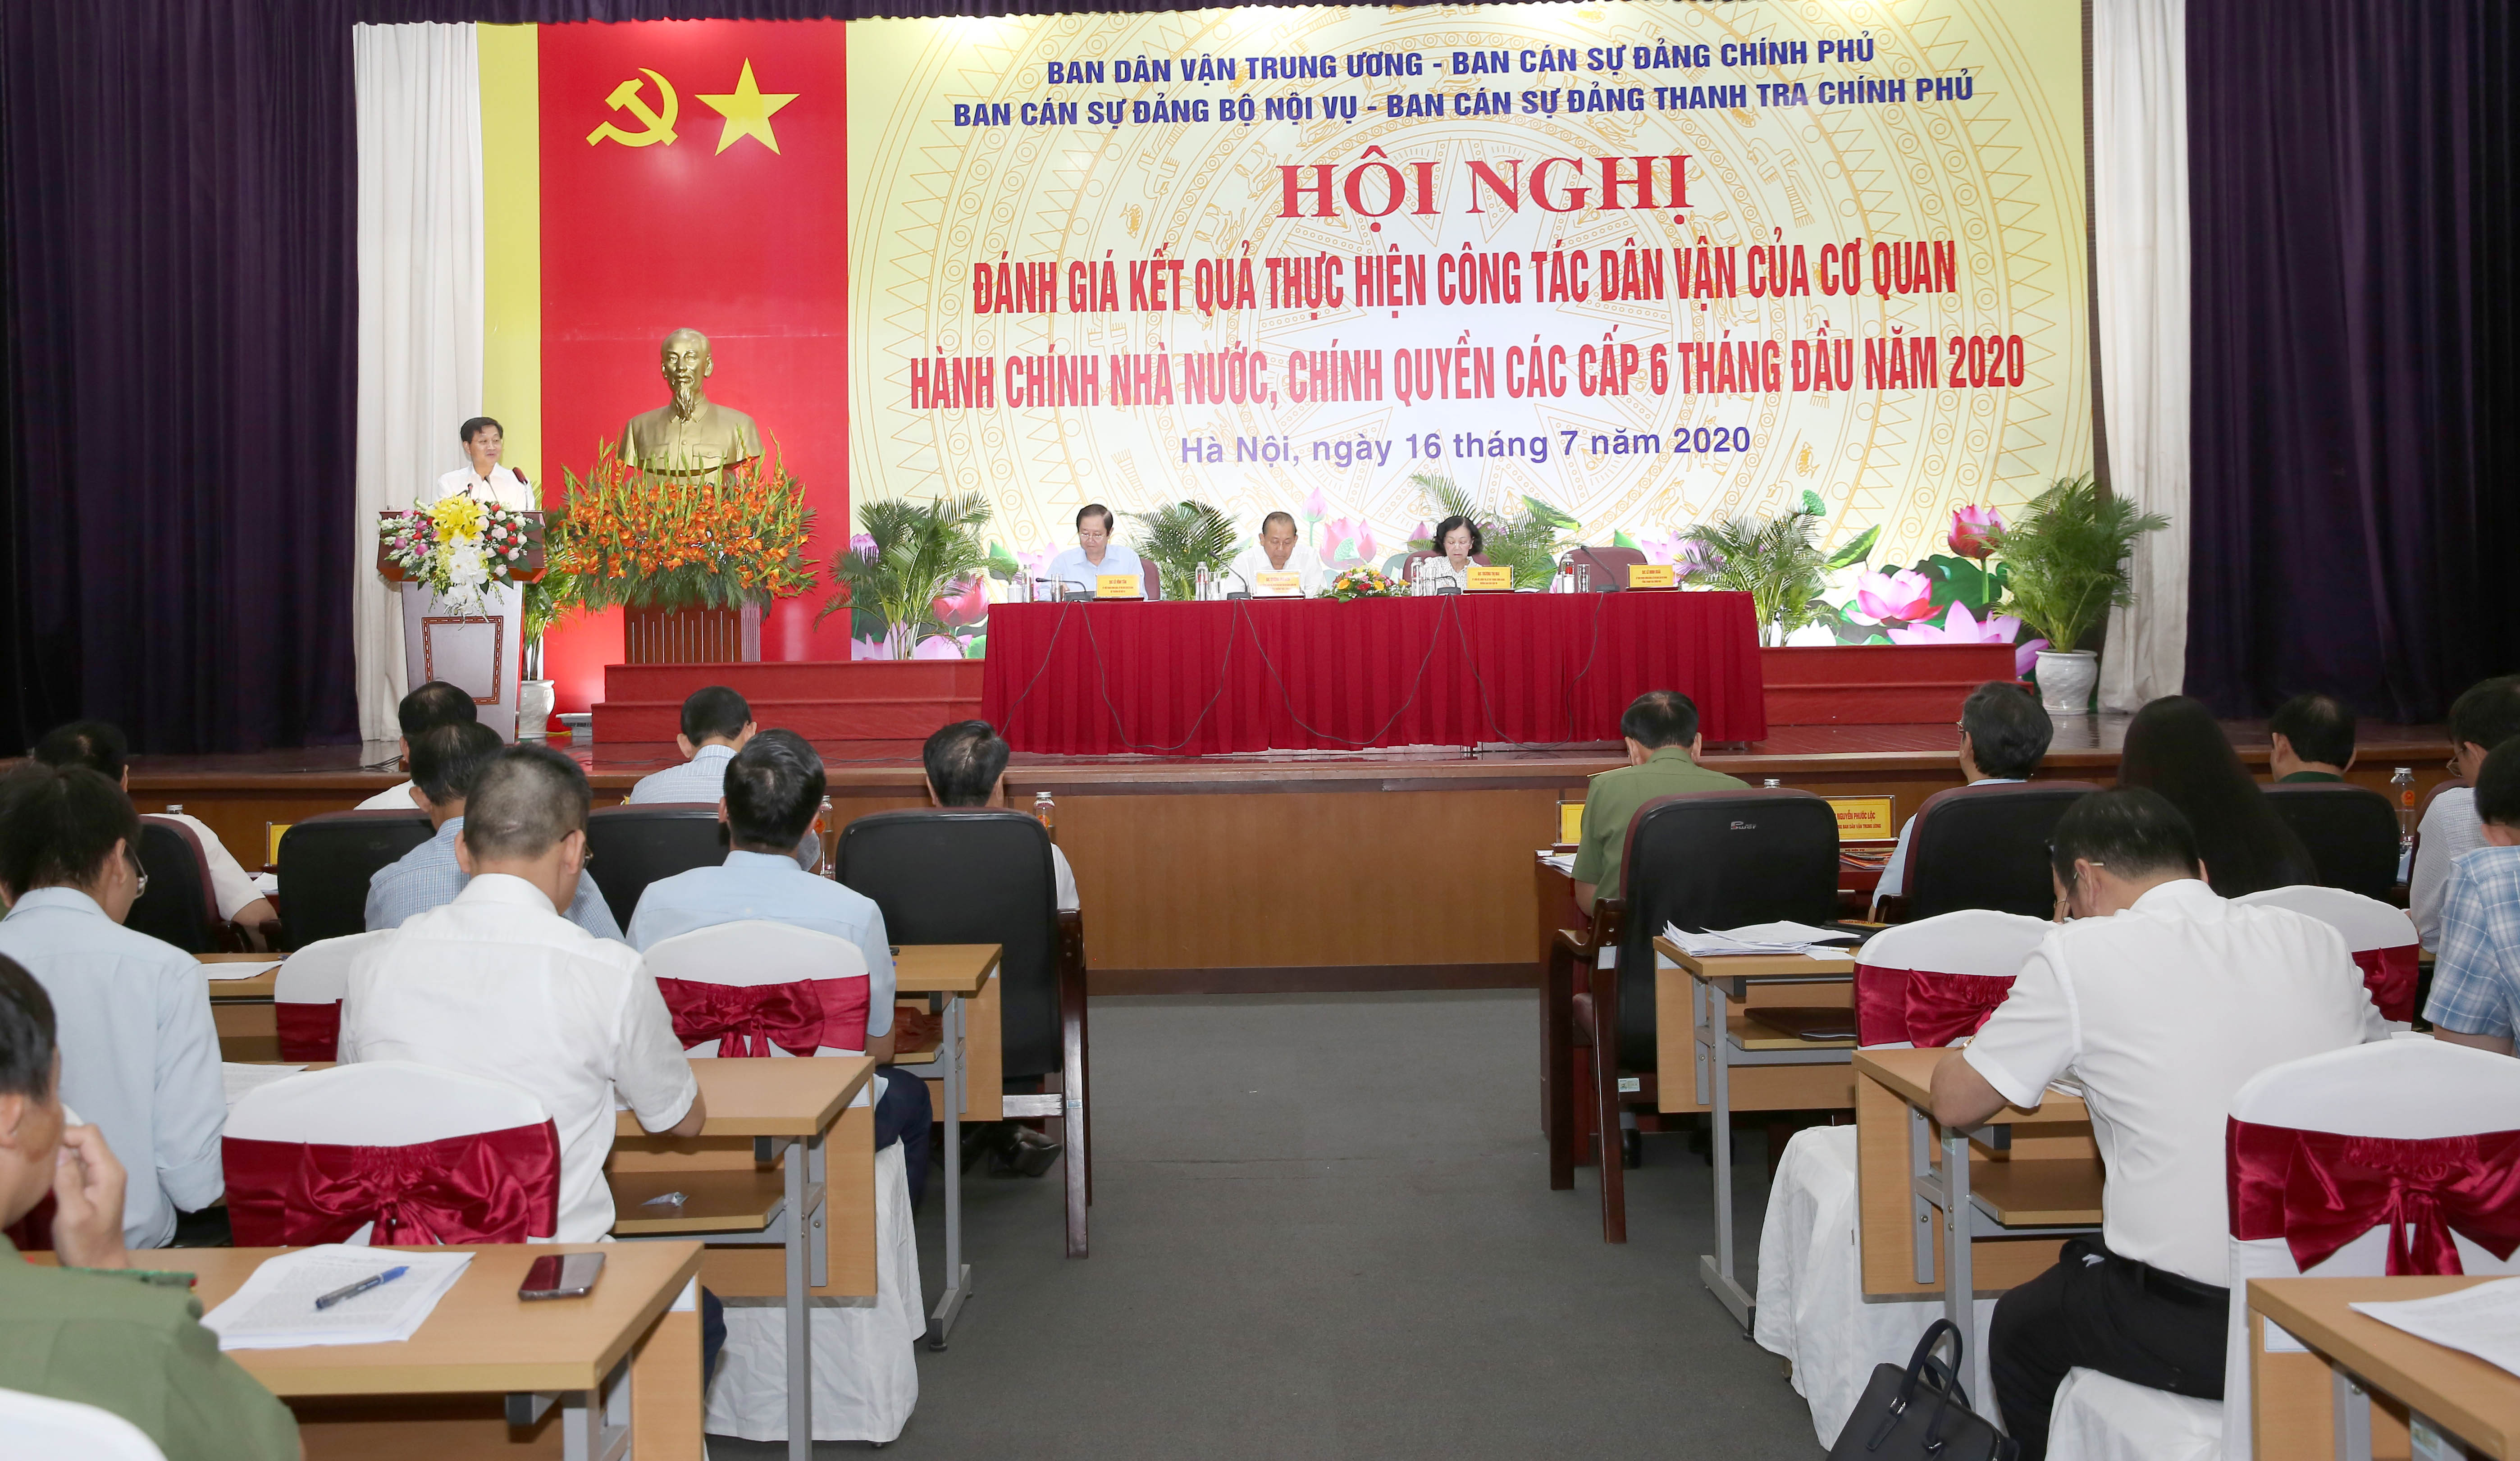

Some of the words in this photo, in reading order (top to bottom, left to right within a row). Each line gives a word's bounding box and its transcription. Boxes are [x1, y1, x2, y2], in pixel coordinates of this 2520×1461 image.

[1049, 61, 1104, 84] BAN
[1115, 55, 1171, 82] DÂN
[1181, 54, 1236, 86] VẬN
[1245, 55, 1337, 80] TRUNG
[1347, 51, 1423, 77] ƯƠNG
[1453, 50, 1509, 74] BAN
[1520, 44, 1577, 73] CÁN
[1588, 45, 1626, 75] SỰ
[1633, 38, 1710, 69] ĐẢNG
[1721, 37, 1807, 66] CHÍNH
[1818, 31, 1873, 63] PHỦ
[955, 103, 1010, 126] BAN
[1022, 97, 1077, 125] CÁN
[1088, 99, 1126, 129] SỰ
[1133, 92, 1209, 123] ĐẢNG
[1219, 93, 1255, 126] BỘ
[1266, 92, 1312, 125] NỘI
[1323, 96, 1357, 124] VỤ
[1387, 93, 1444, 118] BAN
[1455, 87, 1511, 116] CÁN
[1522, 88, 1561, 119] SỰ
[1568, 82, 1644, 112] ĐẢNG
[1654, 85, 1747, 110] THANH
[1757, 83, 1808, 107] TRA
[1819, 75, 1905, 105] CHÍNH
[1917, 69, 1972, 101] PHỦ
[1276, 145, 1440, 233] HỘI
[1465, 155, 1694, 225] NGHỊ
[973, 251, 1057, 314] ĐÁNH
[1068, 249, 1119, 313] GIÁ
[1130, 242, 1184, 311] KẾT
[1195, 240, 1256, 317] QUẢ
[1265, 251, 1344, 320] THỰC
[1355, 243, 1426, 319] HIỆN
[1438, 242, 1521, 306] CÔNG
[1531, 238, 1589, 303] TÁC
[1600, 237, 1664, 302] DÂN
[1673, 235, 1737, 311] VẬN
[1747, 227, 1810, 298] CỦA
[1820, 237, 1862, 296] CƠ
[1872, 240, 1956, 301] QUAN
[911, 346, 994, 409] HÀNH
[1005, 343, 1099, 408] CHÍNH
[1111, 342, 1173, 406] NHÀ
[1184, 341, 1277, 410] NƯỚC,
[1289, 338, 1382, 403] CHÍNH
[1395, 329, 1494, 406] QUYỀN
[1507, 334, 1566, 398] CÁC
[1578, 324, 1639, 397] CẤP
[1650, 343, 1669, 395] 6
[1678, 329, 1781, 394] THÁNG
[1791, 320, 1853, 392] ĐẦU
[1865, 326, 1938, 390] NĂM
[1949, 335, 2024, 388] 2020
[1182, 437, 1222, 463] Hà
[1237, 435, 1298, 467] Nội,
[1314, 433, 1392, 467] ngày
[1406, 433, 1441, 458] 16
[1453, 430, 1548, 463] tháng
[1561, 430, 1578, 456] 7
[1592, 426, 1660, 455] năm
[1674, 426, 1750, 453] 2020
